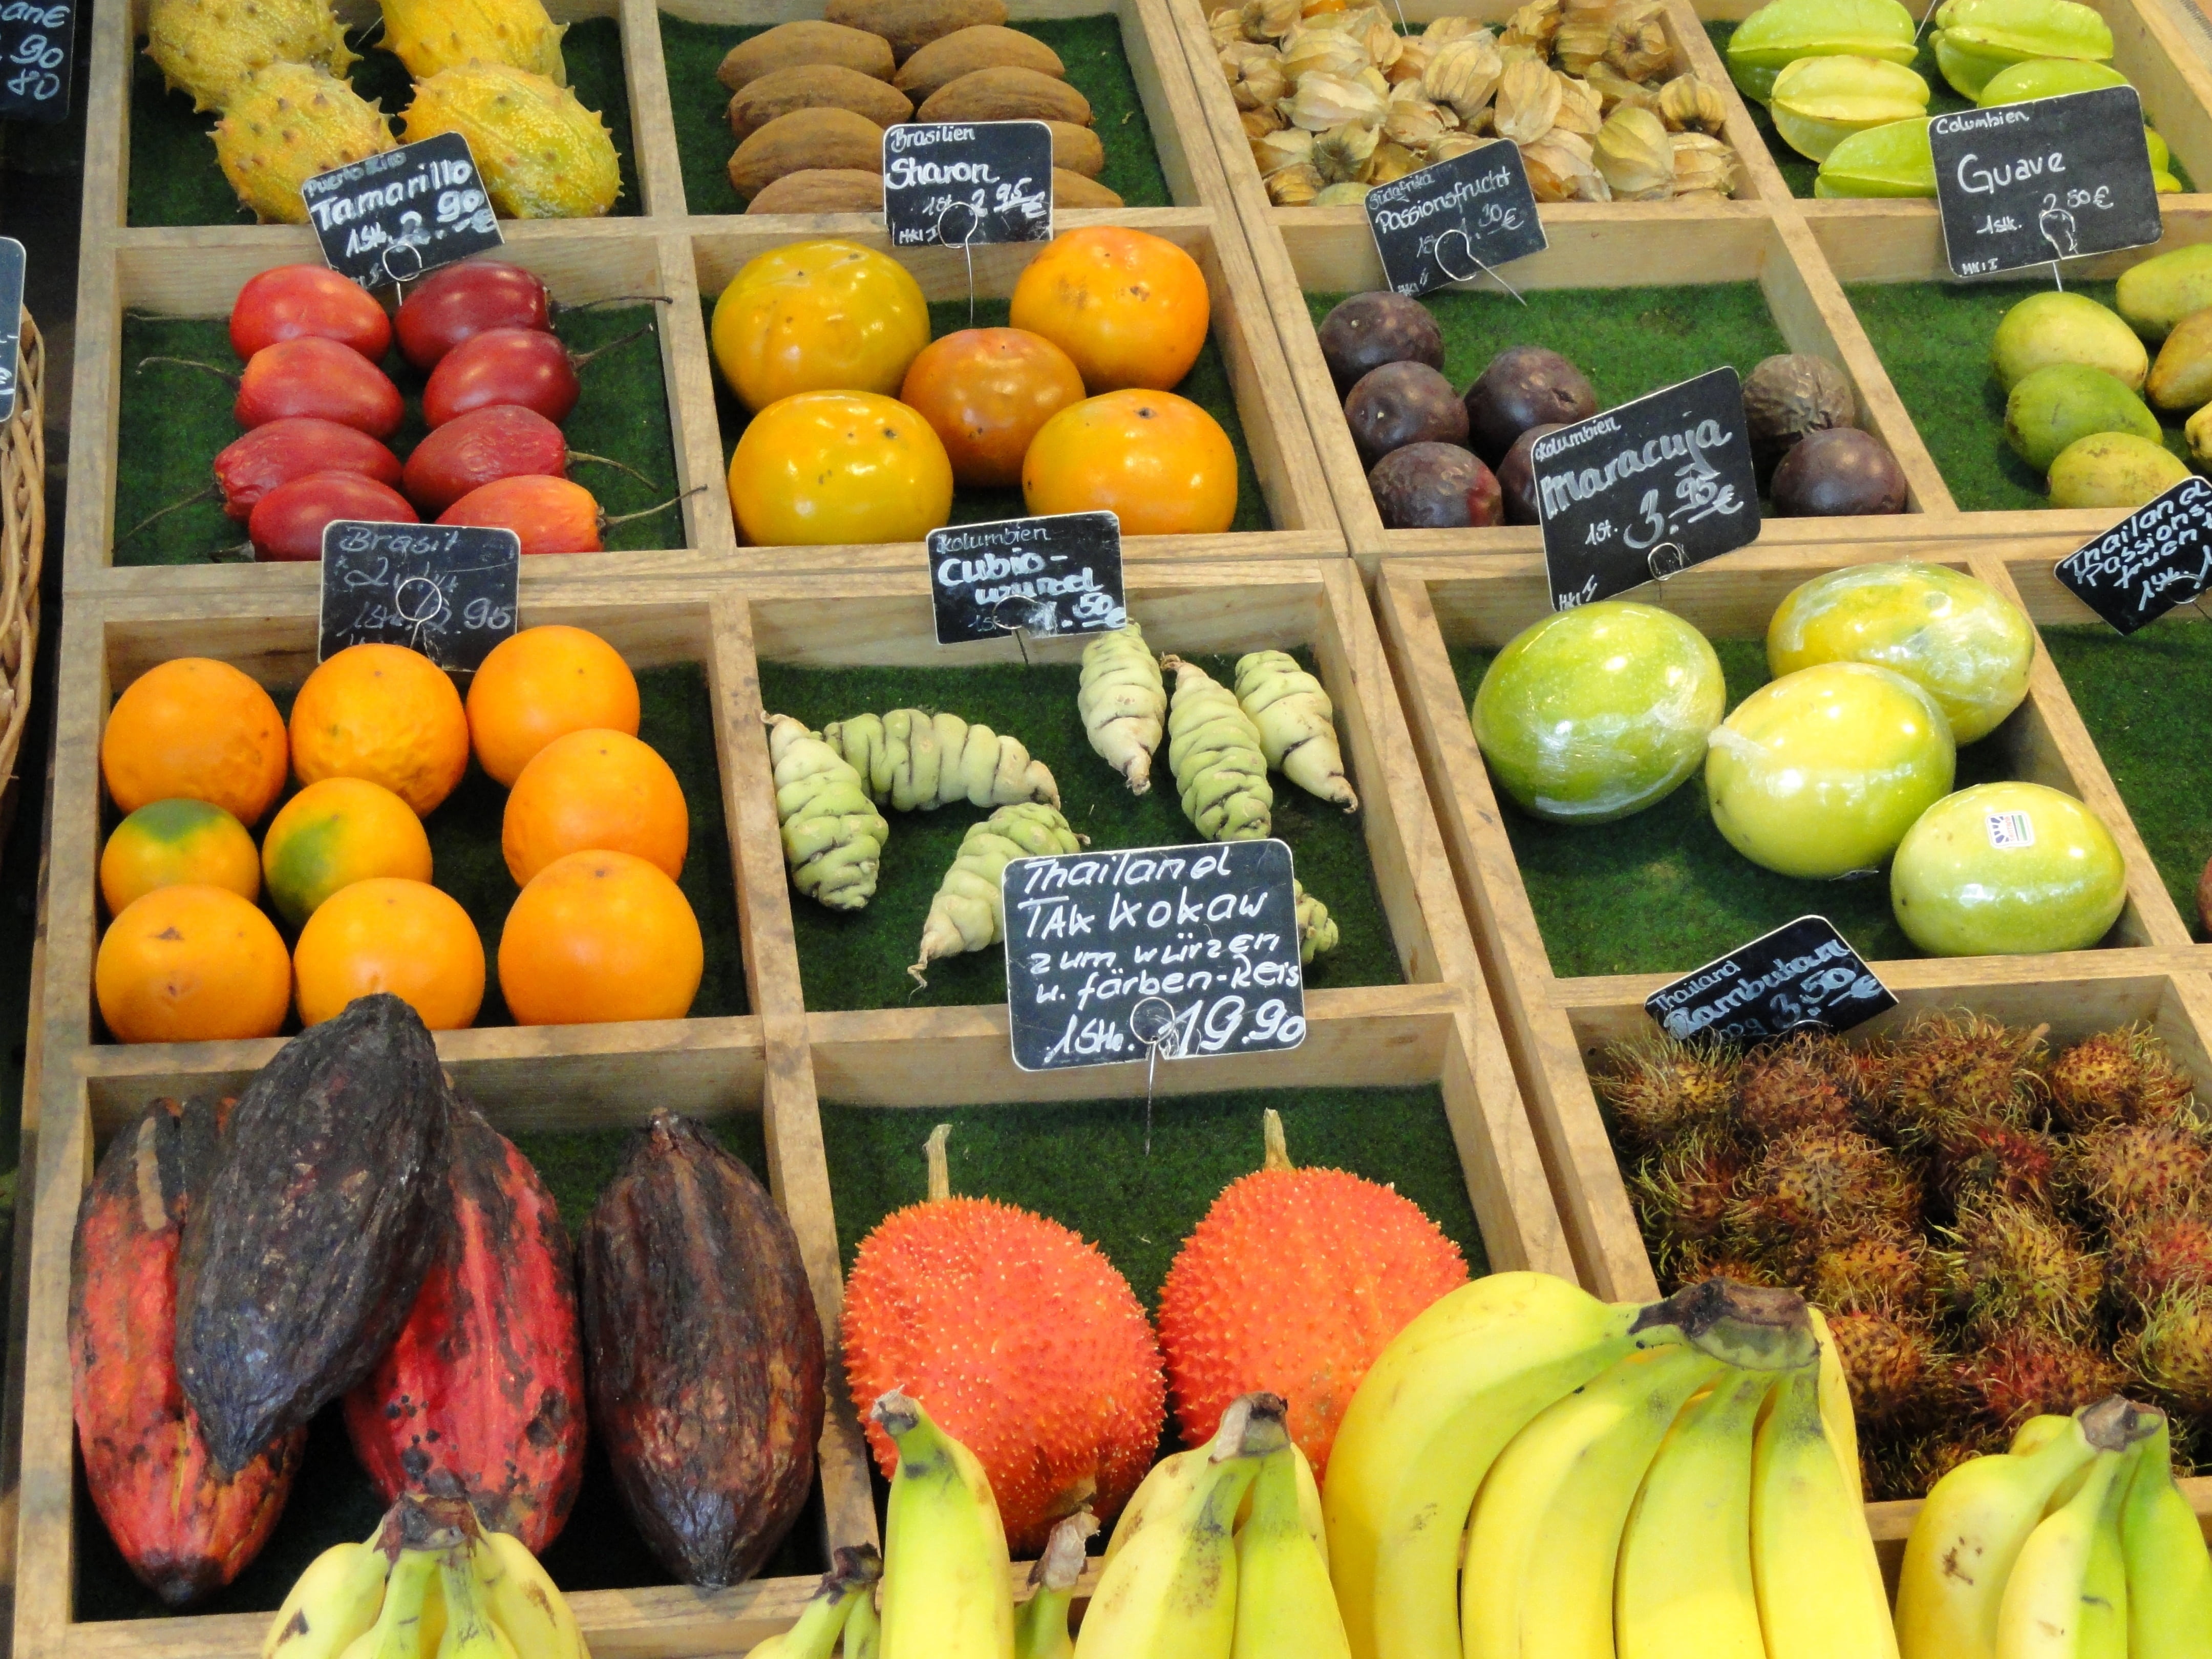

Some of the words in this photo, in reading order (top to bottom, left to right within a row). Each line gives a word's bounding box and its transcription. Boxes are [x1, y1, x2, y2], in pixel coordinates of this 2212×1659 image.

[309, 159, 473, 231] Tamarillo
[885, 157, 1000, 189] Sharon
[1958, 153, 2066, 194] Guave
[1375, 166, 1511, 233] Passionsfrucht
[1024, 846, 1231, 894] Thailand
[1647, 960, 1741, 1011] Thailand
